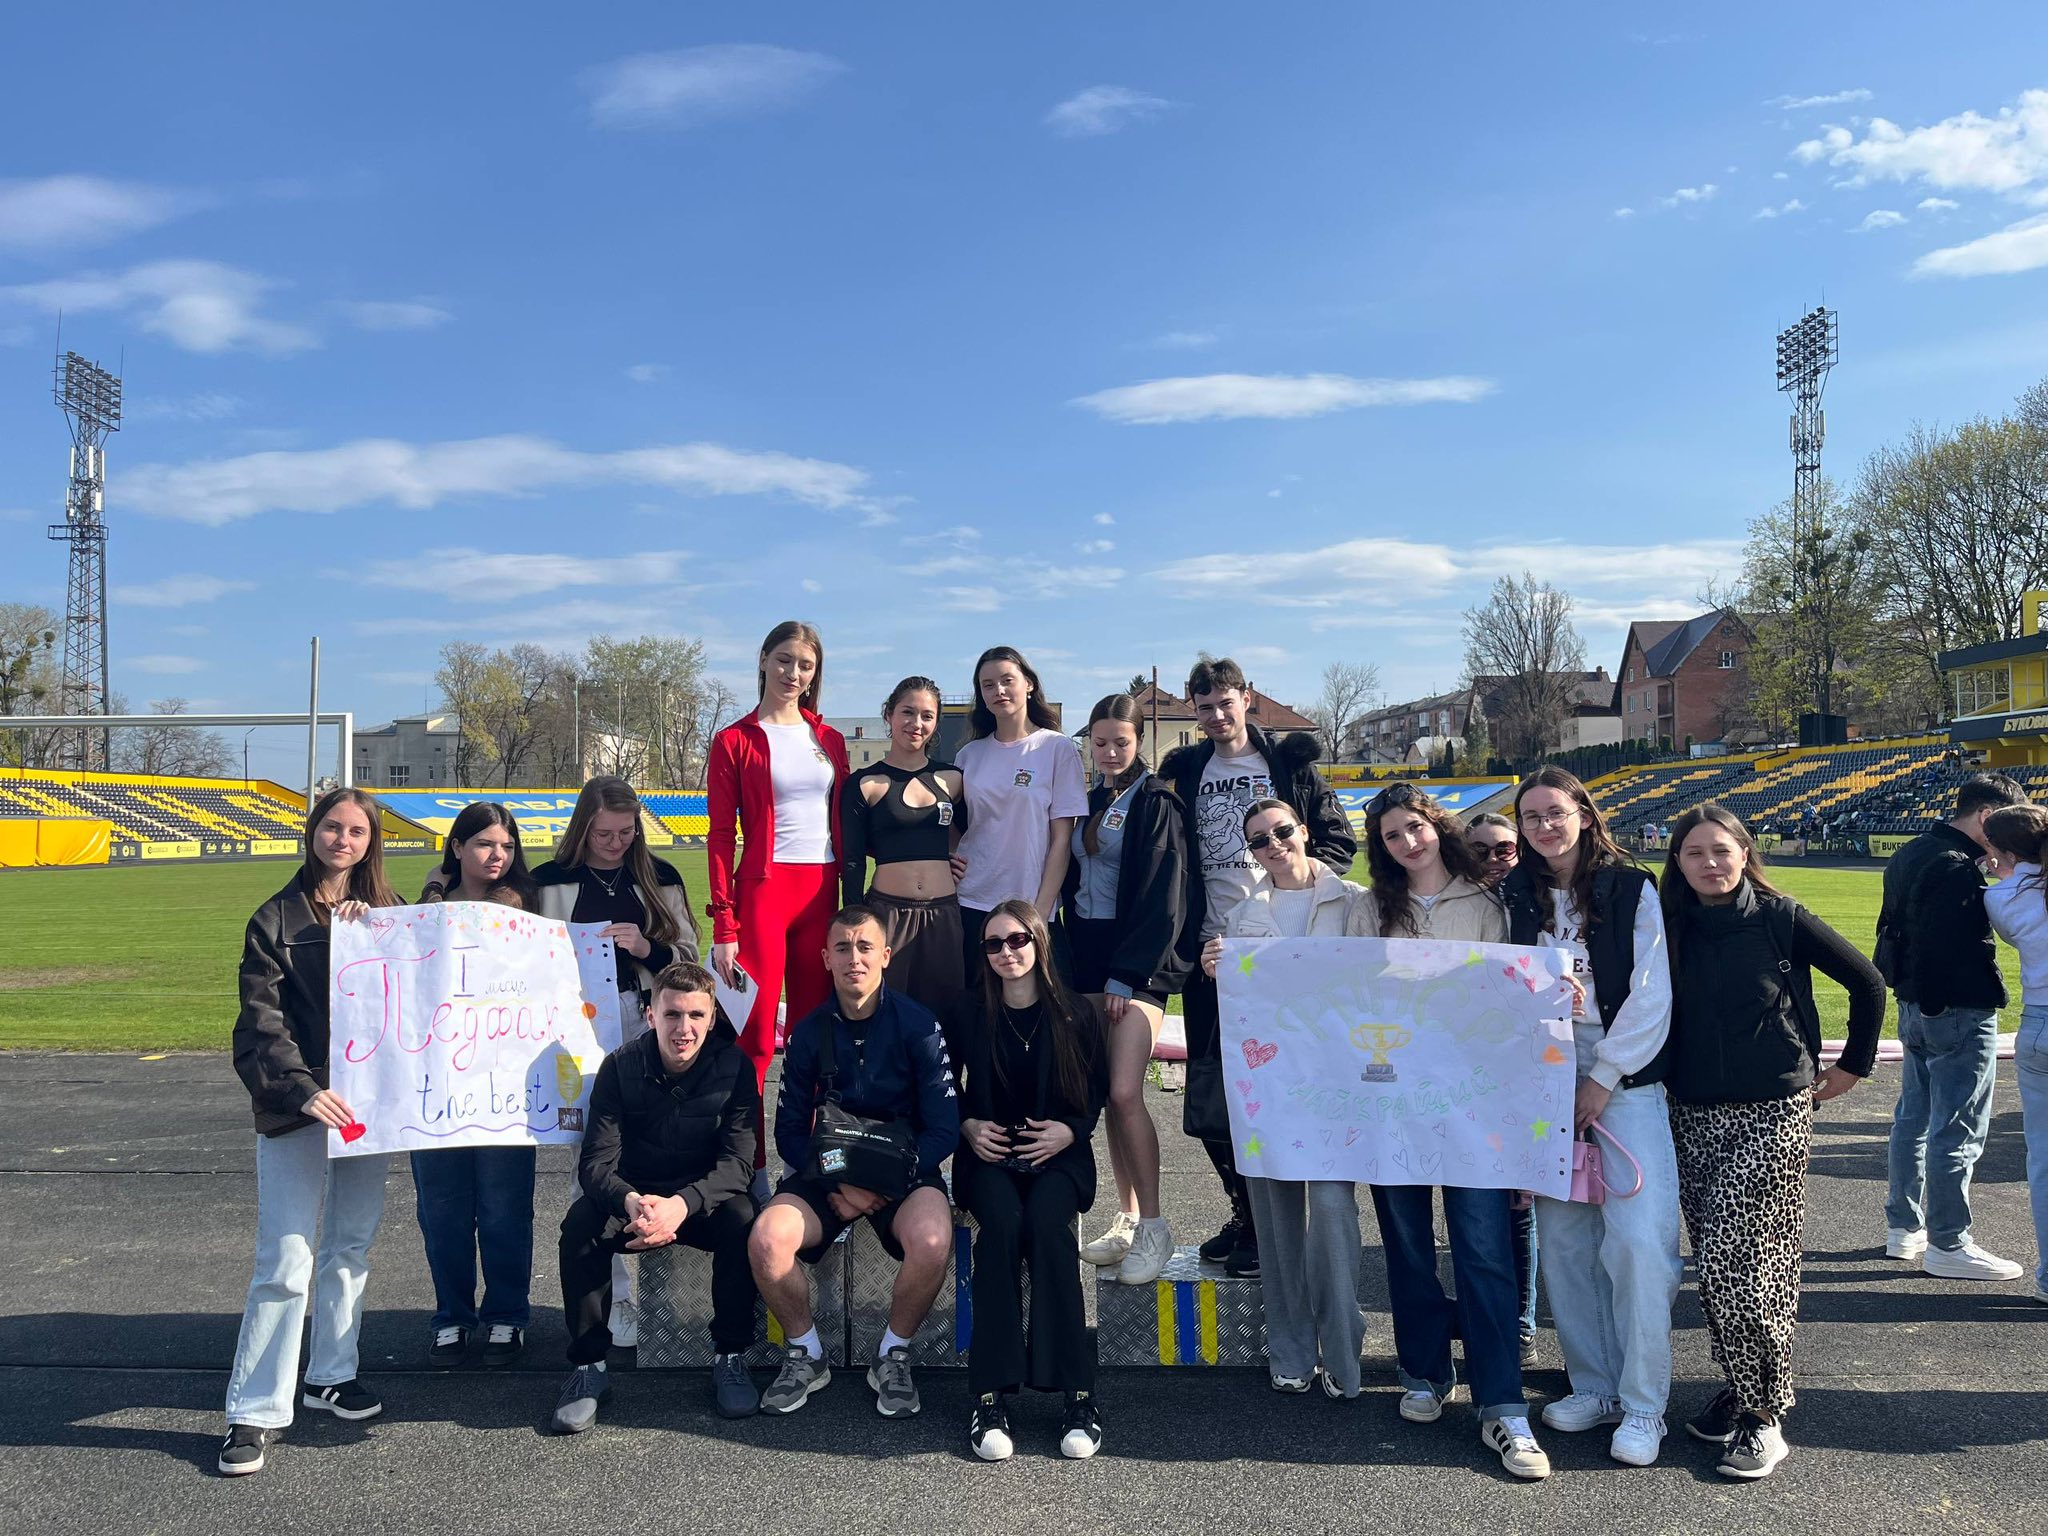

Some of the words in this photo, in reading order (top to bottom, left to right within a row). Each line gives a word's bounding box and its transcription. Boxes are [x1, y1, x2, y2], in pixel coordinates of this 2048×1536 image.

[1201, 774, 1266, 796] OWS
[417, 1072, 478, 1124] the
[489, 1071, 550, 1116] best
